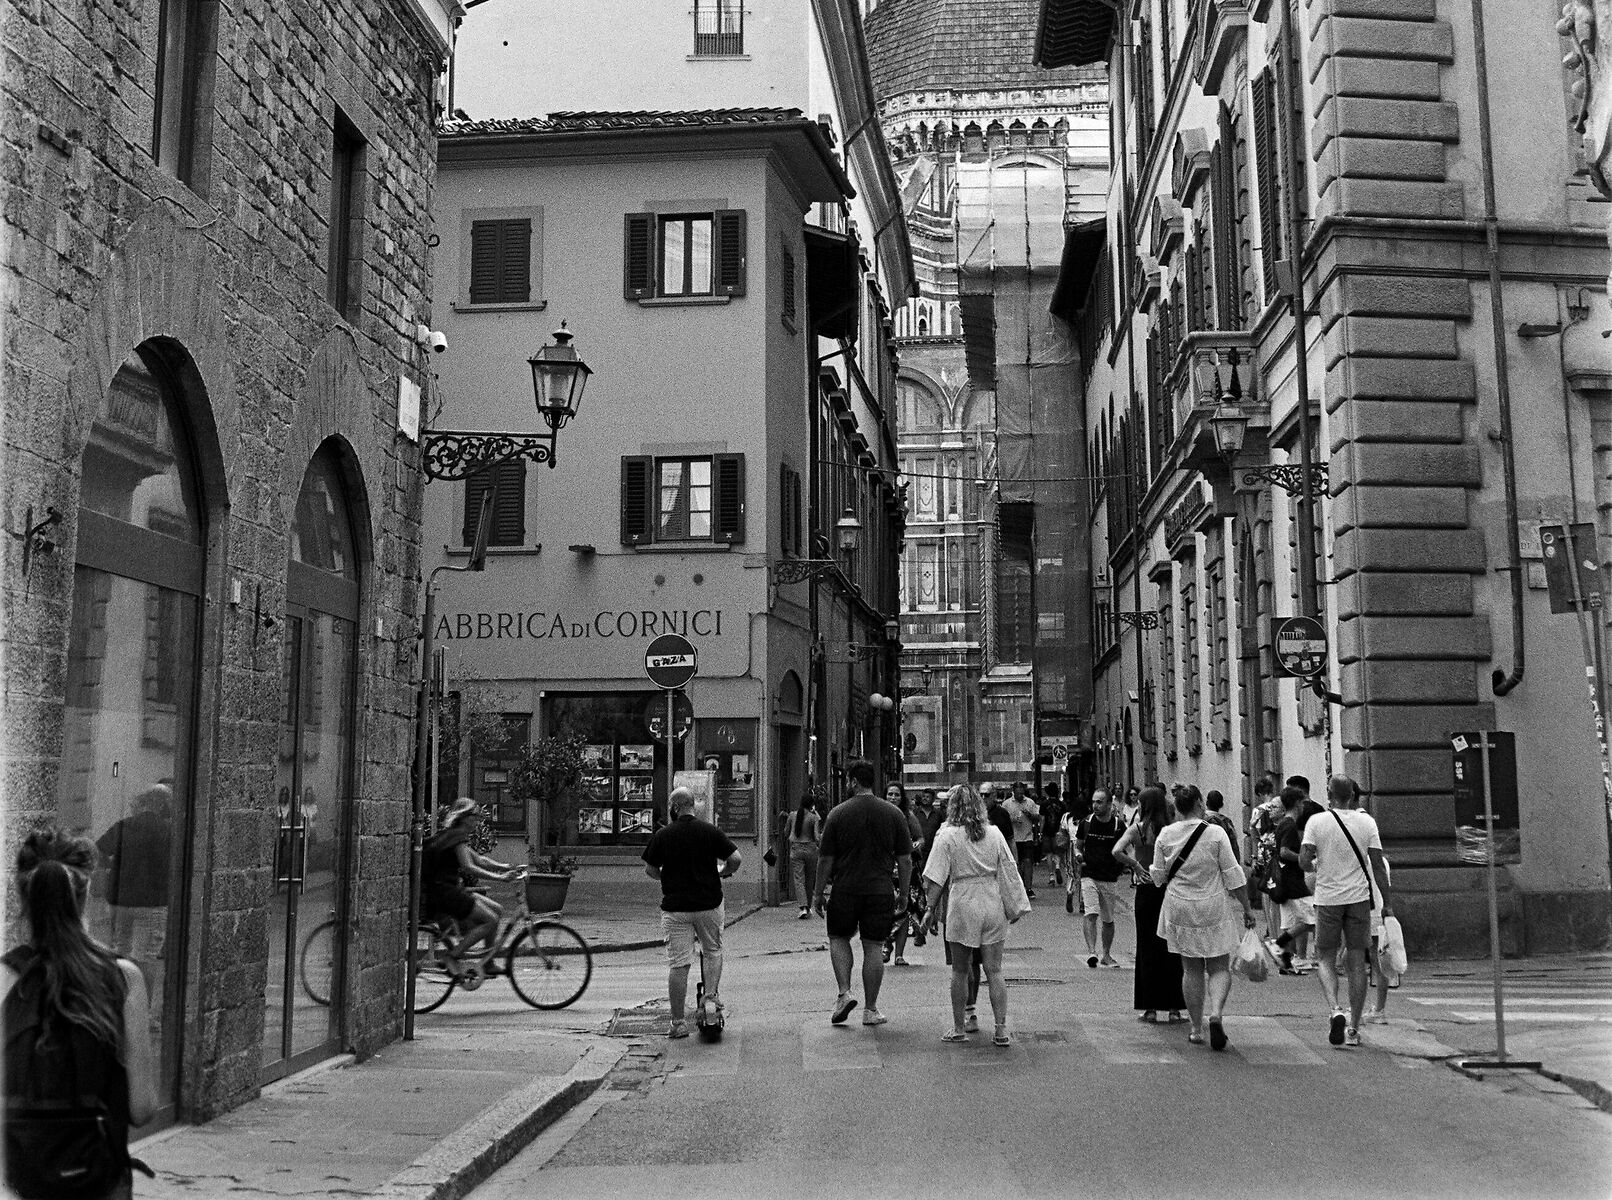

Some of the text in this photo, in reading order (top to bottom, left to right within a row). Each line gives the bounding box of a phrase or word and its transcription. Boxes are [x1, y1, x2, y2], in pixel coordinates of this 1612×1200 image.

[421, 610, 722, 639] ABBRICA DI CORNICI
[652, 655, 687, 667] GAZA
